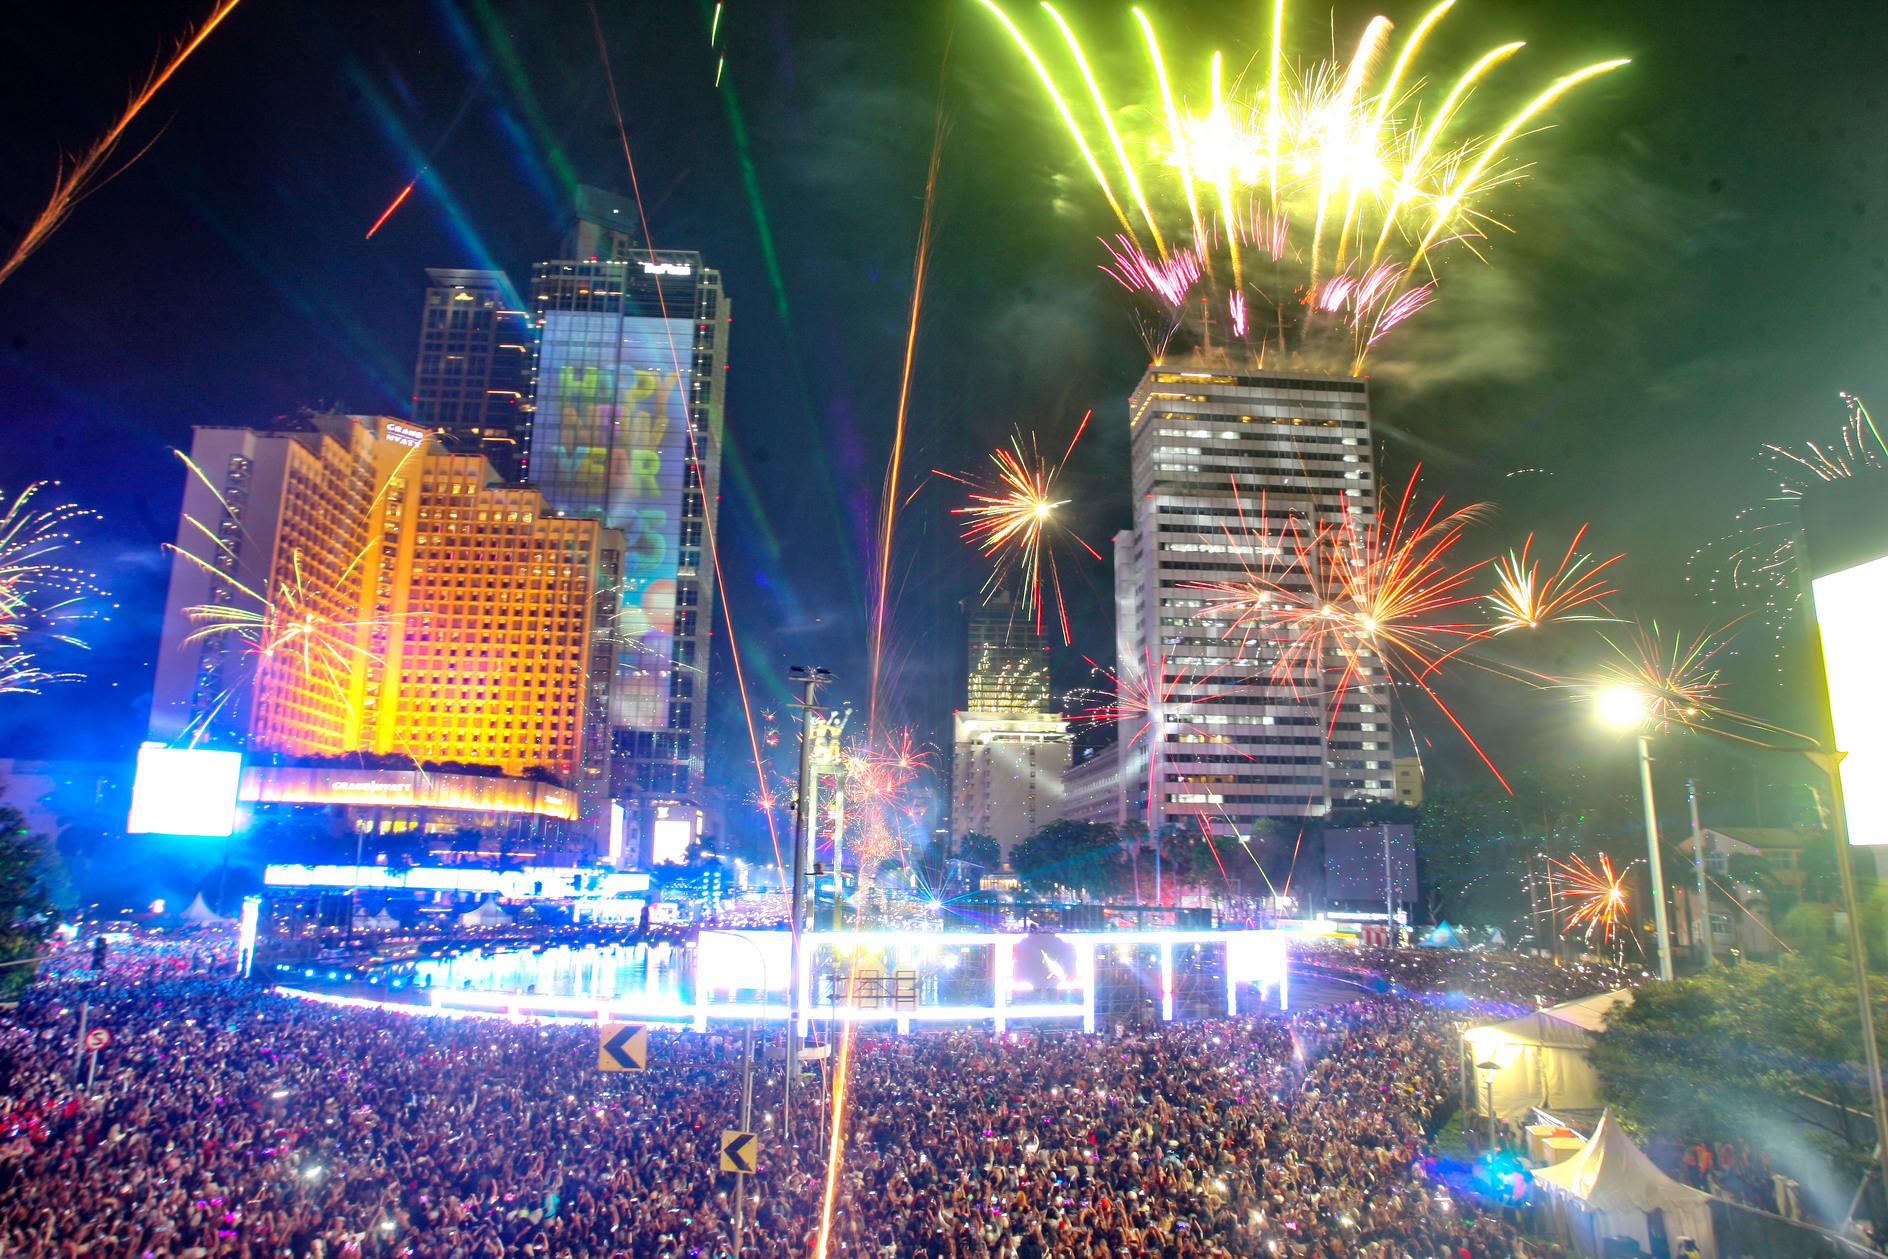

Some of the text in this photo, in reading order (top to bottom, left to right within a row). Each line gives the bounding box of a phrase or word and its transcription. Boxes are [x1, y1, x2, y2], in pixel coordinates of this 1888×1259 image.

[559, 364, 678, 416] HAPPY
[386, 423, 424, 439] GRAND
[386, 433, 421, 448] HYATT
[560, 404, 669, 453] NEW
[551, 445, 662, 498] YEAR
[375, 783, 412, 792] HYATT
